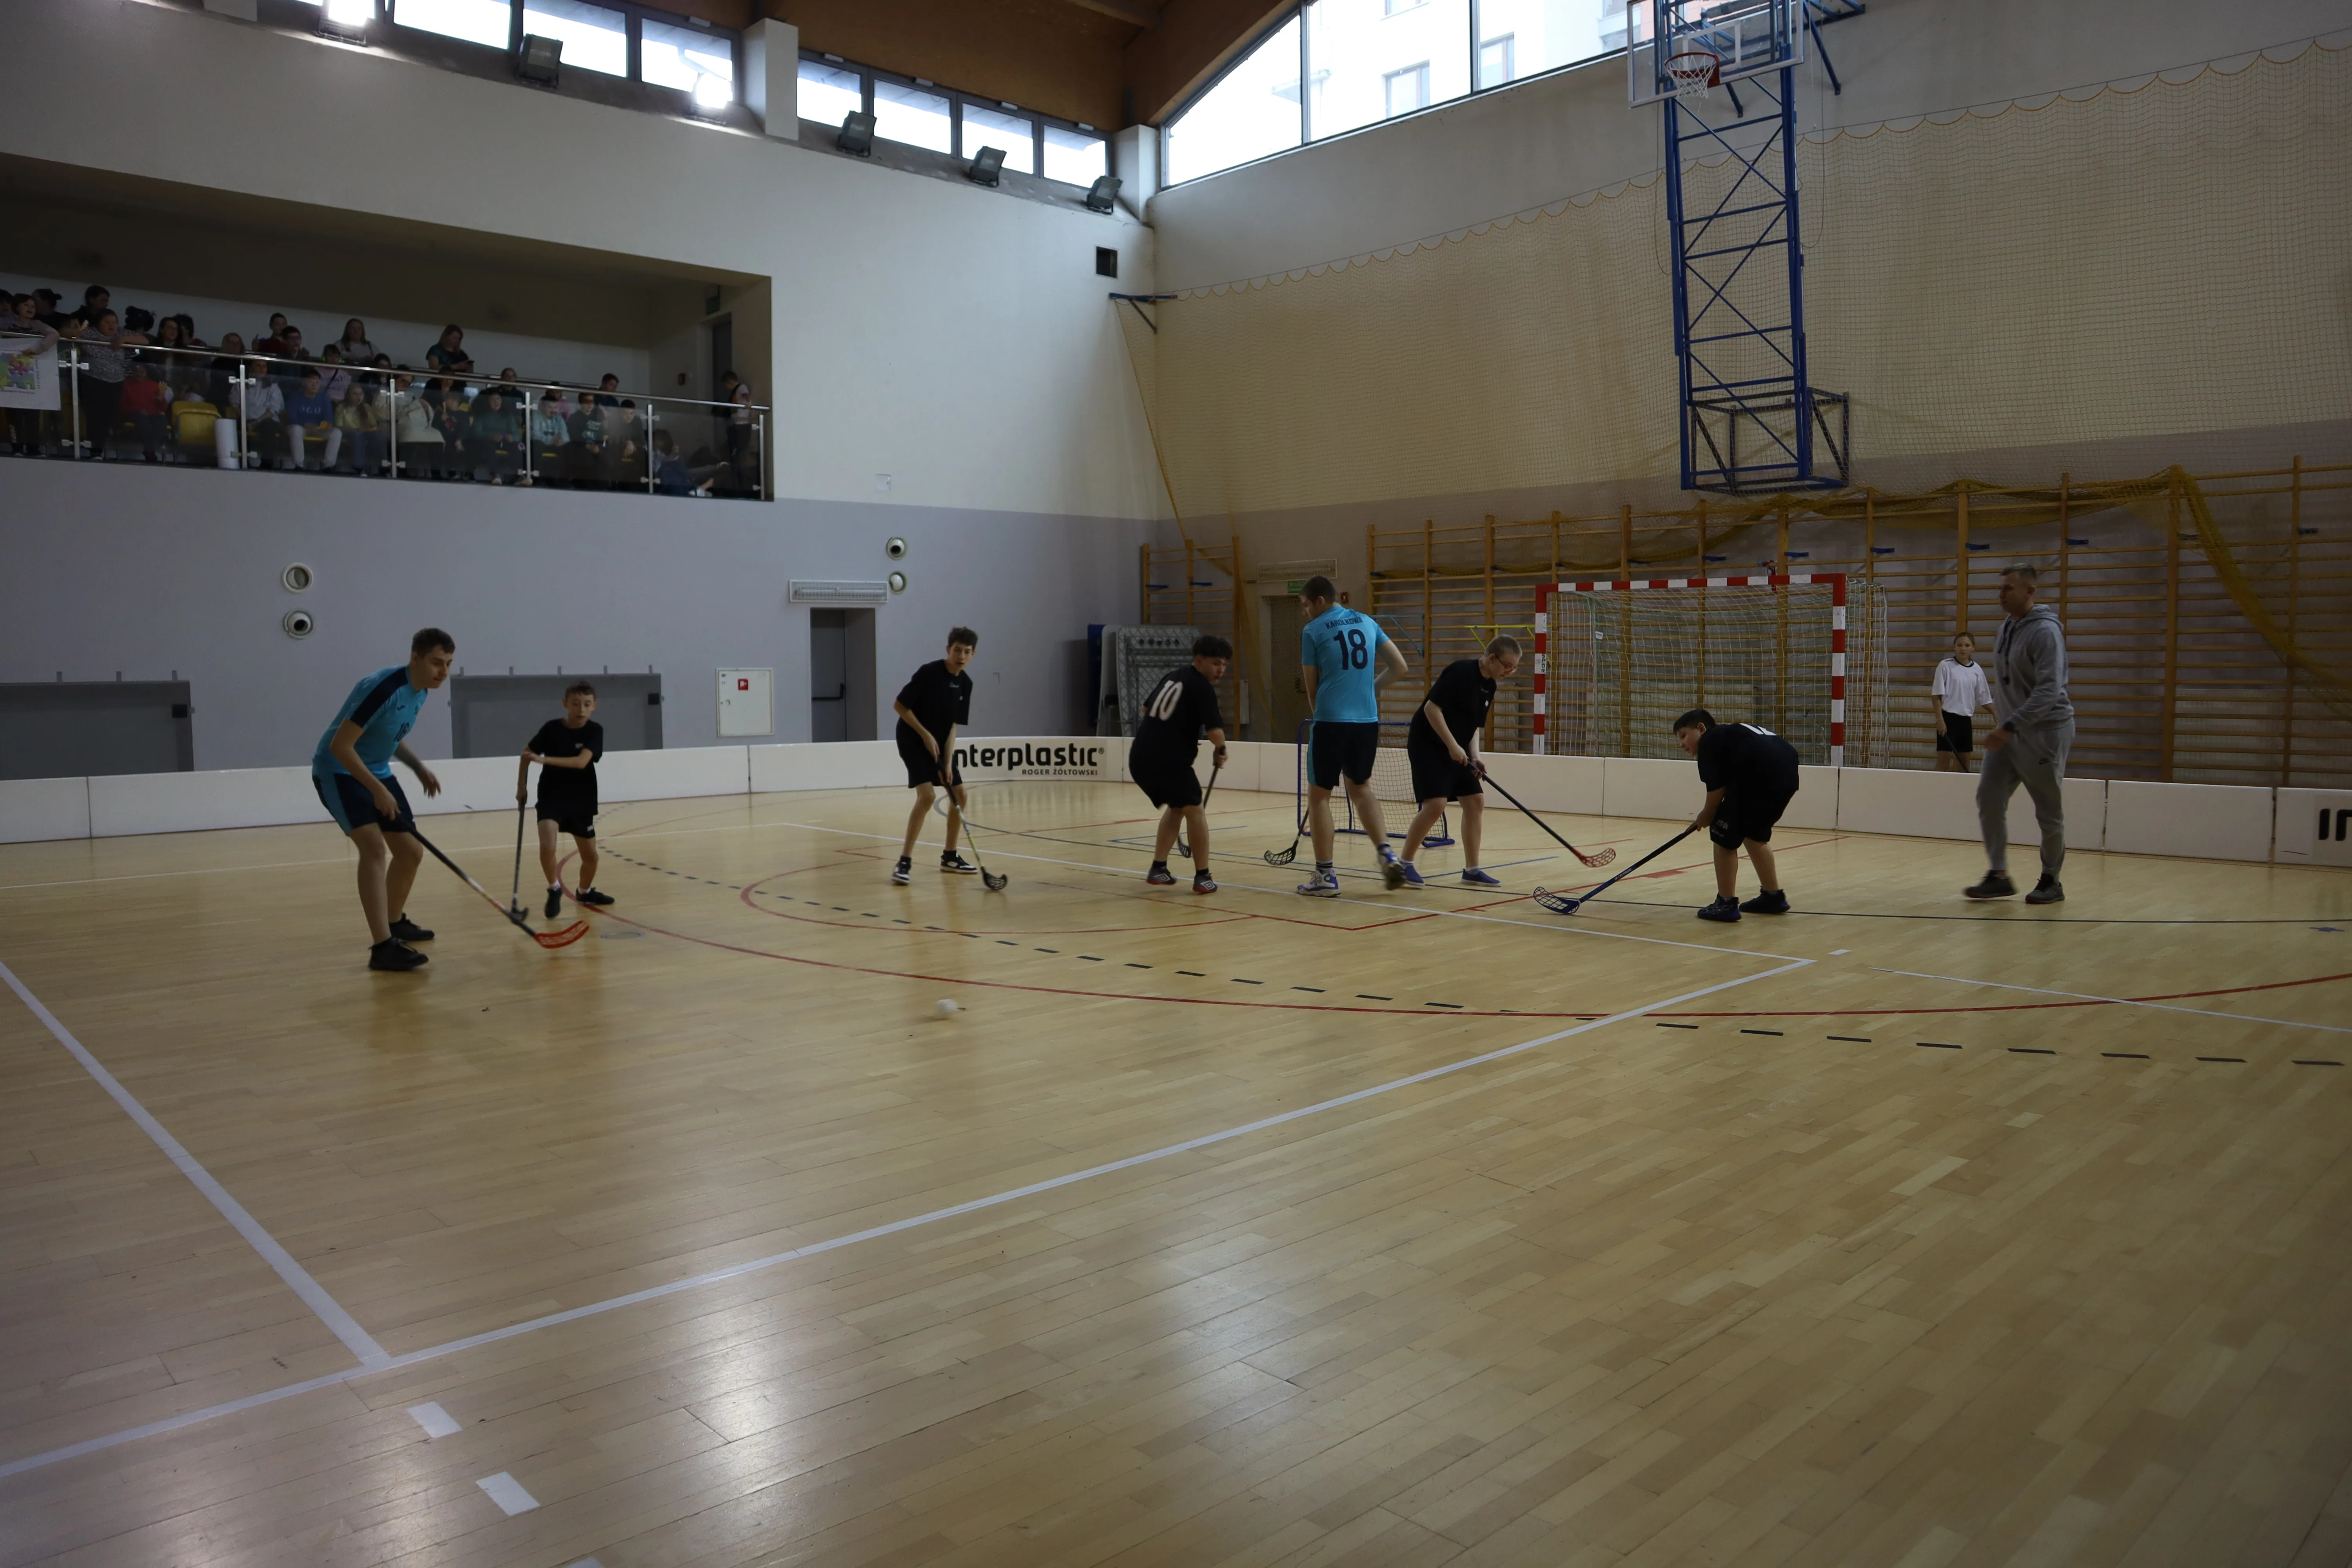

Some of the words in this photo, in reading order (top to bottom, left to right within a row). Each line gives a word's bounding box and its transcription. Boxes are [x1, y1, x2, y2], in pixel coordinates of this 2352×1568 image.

[1325, 616, 1363, 629] KAROLKOWA
[1334, 629, 1368, 670] 18
[1149, 679, 1183, 721] 10
[1053, 767, 1098, 776] ŻÓŁTOWSKI
